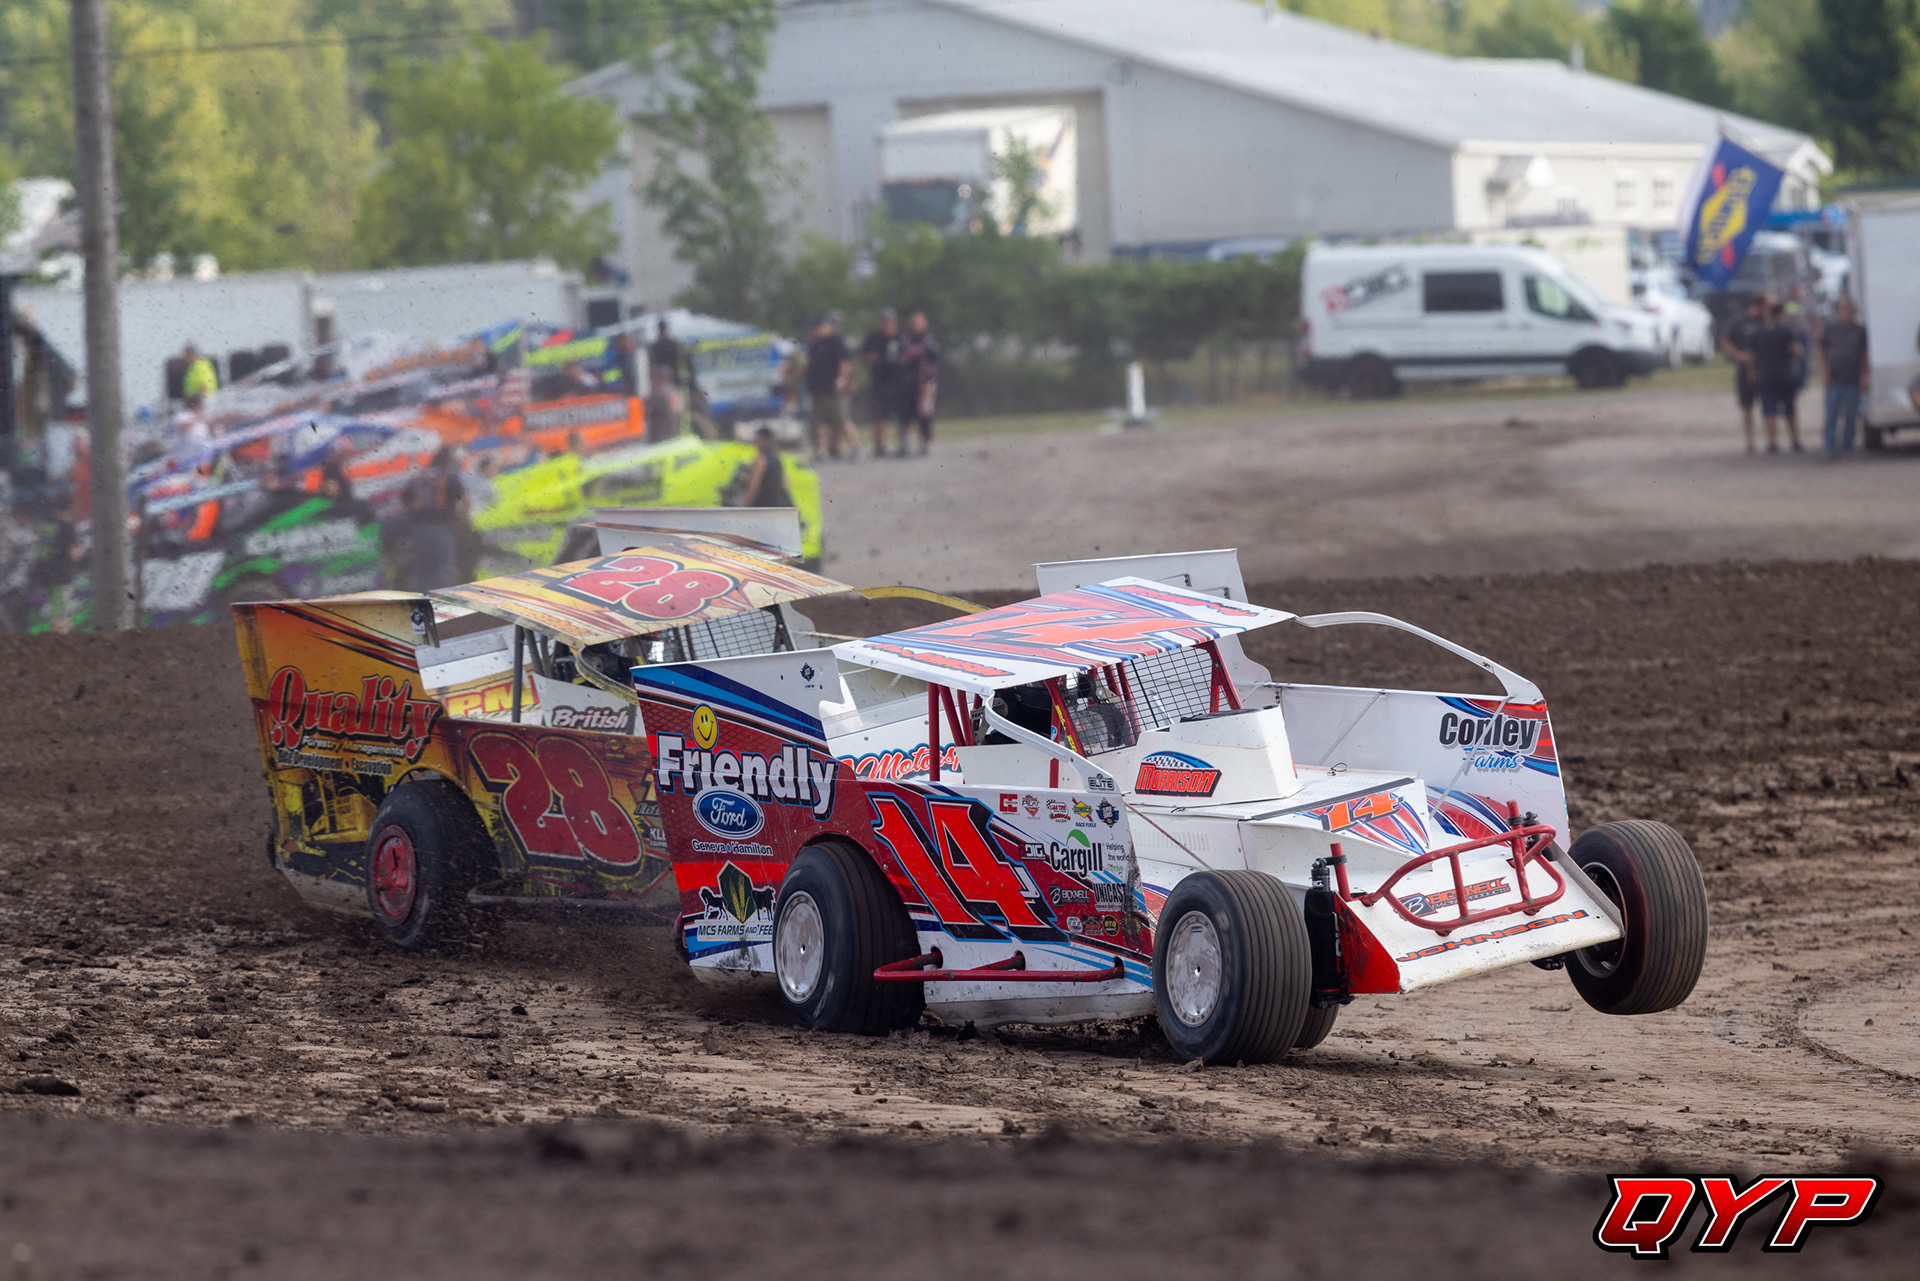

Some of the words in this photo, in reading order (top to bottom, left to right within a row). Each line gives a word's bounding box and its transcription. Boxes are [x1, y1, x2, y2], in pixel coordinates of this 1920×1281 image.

[561, 554, 737, 620] 28
[267, 665, 443, 762] Quality
[552, 706, 629, 731] British
[302, 735, 341, 753] Forestry
[1439, 711, 1538, 751] Conley
[656, 731, 840, 822] Friendly
[855, 746, 960, 780] Motos
[1135, 764, 1219, 795] MORRISON
[468, 731, 645, 877] 28
[709, 796, 748, 828] Ford
[1323, 790, 1400, 832] 14
[691, 838, 727, 854] Geneva
[731, 841, 774, 857] Hamilton
[1050, 841, 1104, 879] Cargill
[1106, 843, 1125, 853] Helping
[867, 793, 1069, 943] 14
[1429, 879, 1508, 905] BICNELL
[1466, 886, 1511, 901] RODUCTS
[697, 924, 717, 936] MCS
[717, 924, 746, 936] FARMS
[745, 926, 758, 935] AND
[1395, 909, 1590, 963] JOHNSON
